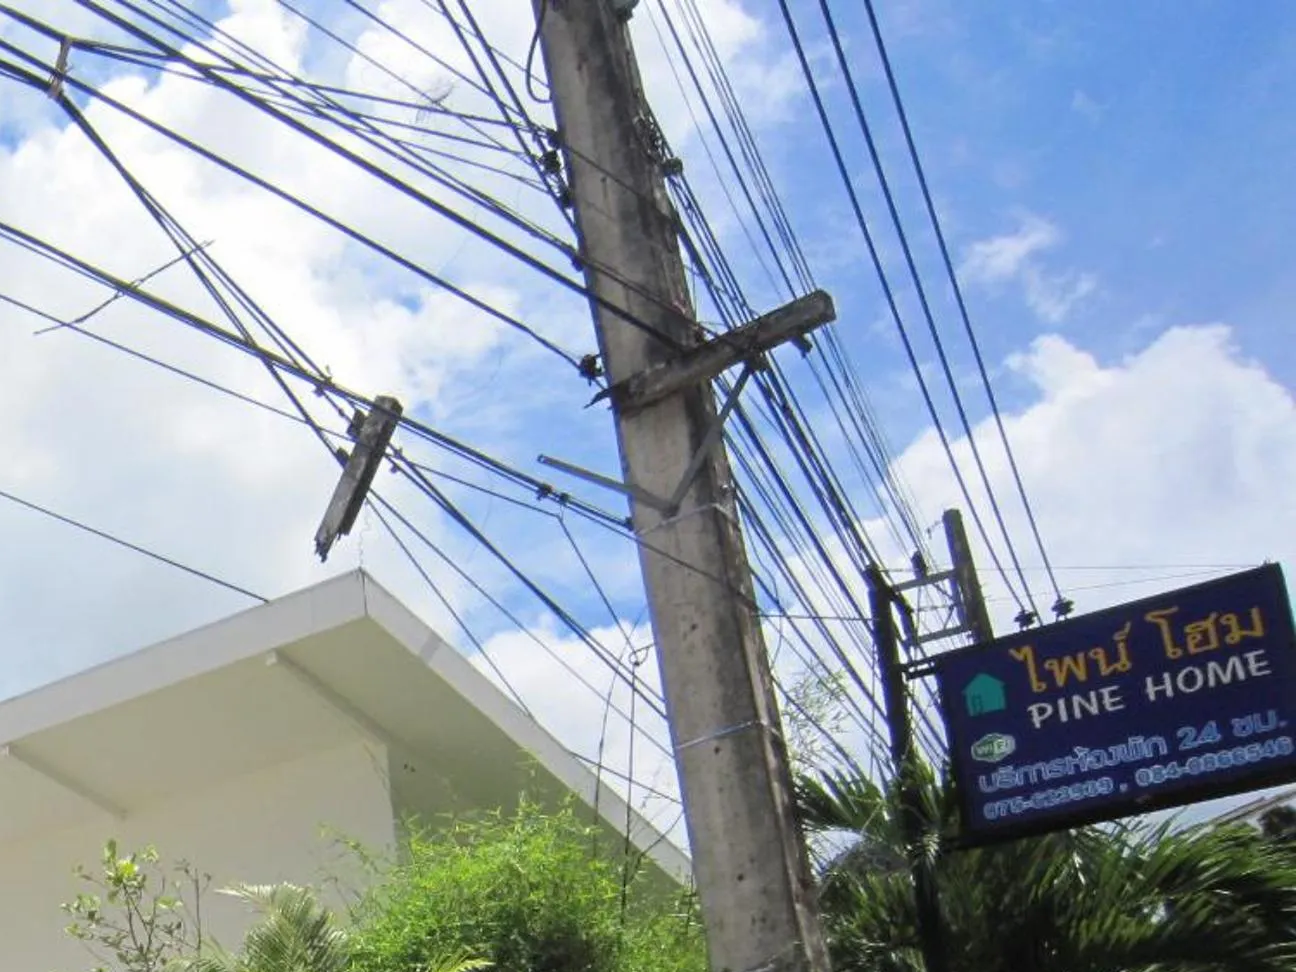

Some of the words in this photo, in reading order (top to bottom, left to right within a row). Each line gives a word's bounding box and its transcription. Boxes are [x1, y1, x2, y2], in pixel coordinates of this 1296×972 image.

[1008, 621, 1132, 693] ไพน์
[1144, 606, 1265, 660] โฮม
[1027, 685, 1125, 729] PINE
[1145, 649, 1272, 701] HOME
[1177, 719, 1222, 751] 24
